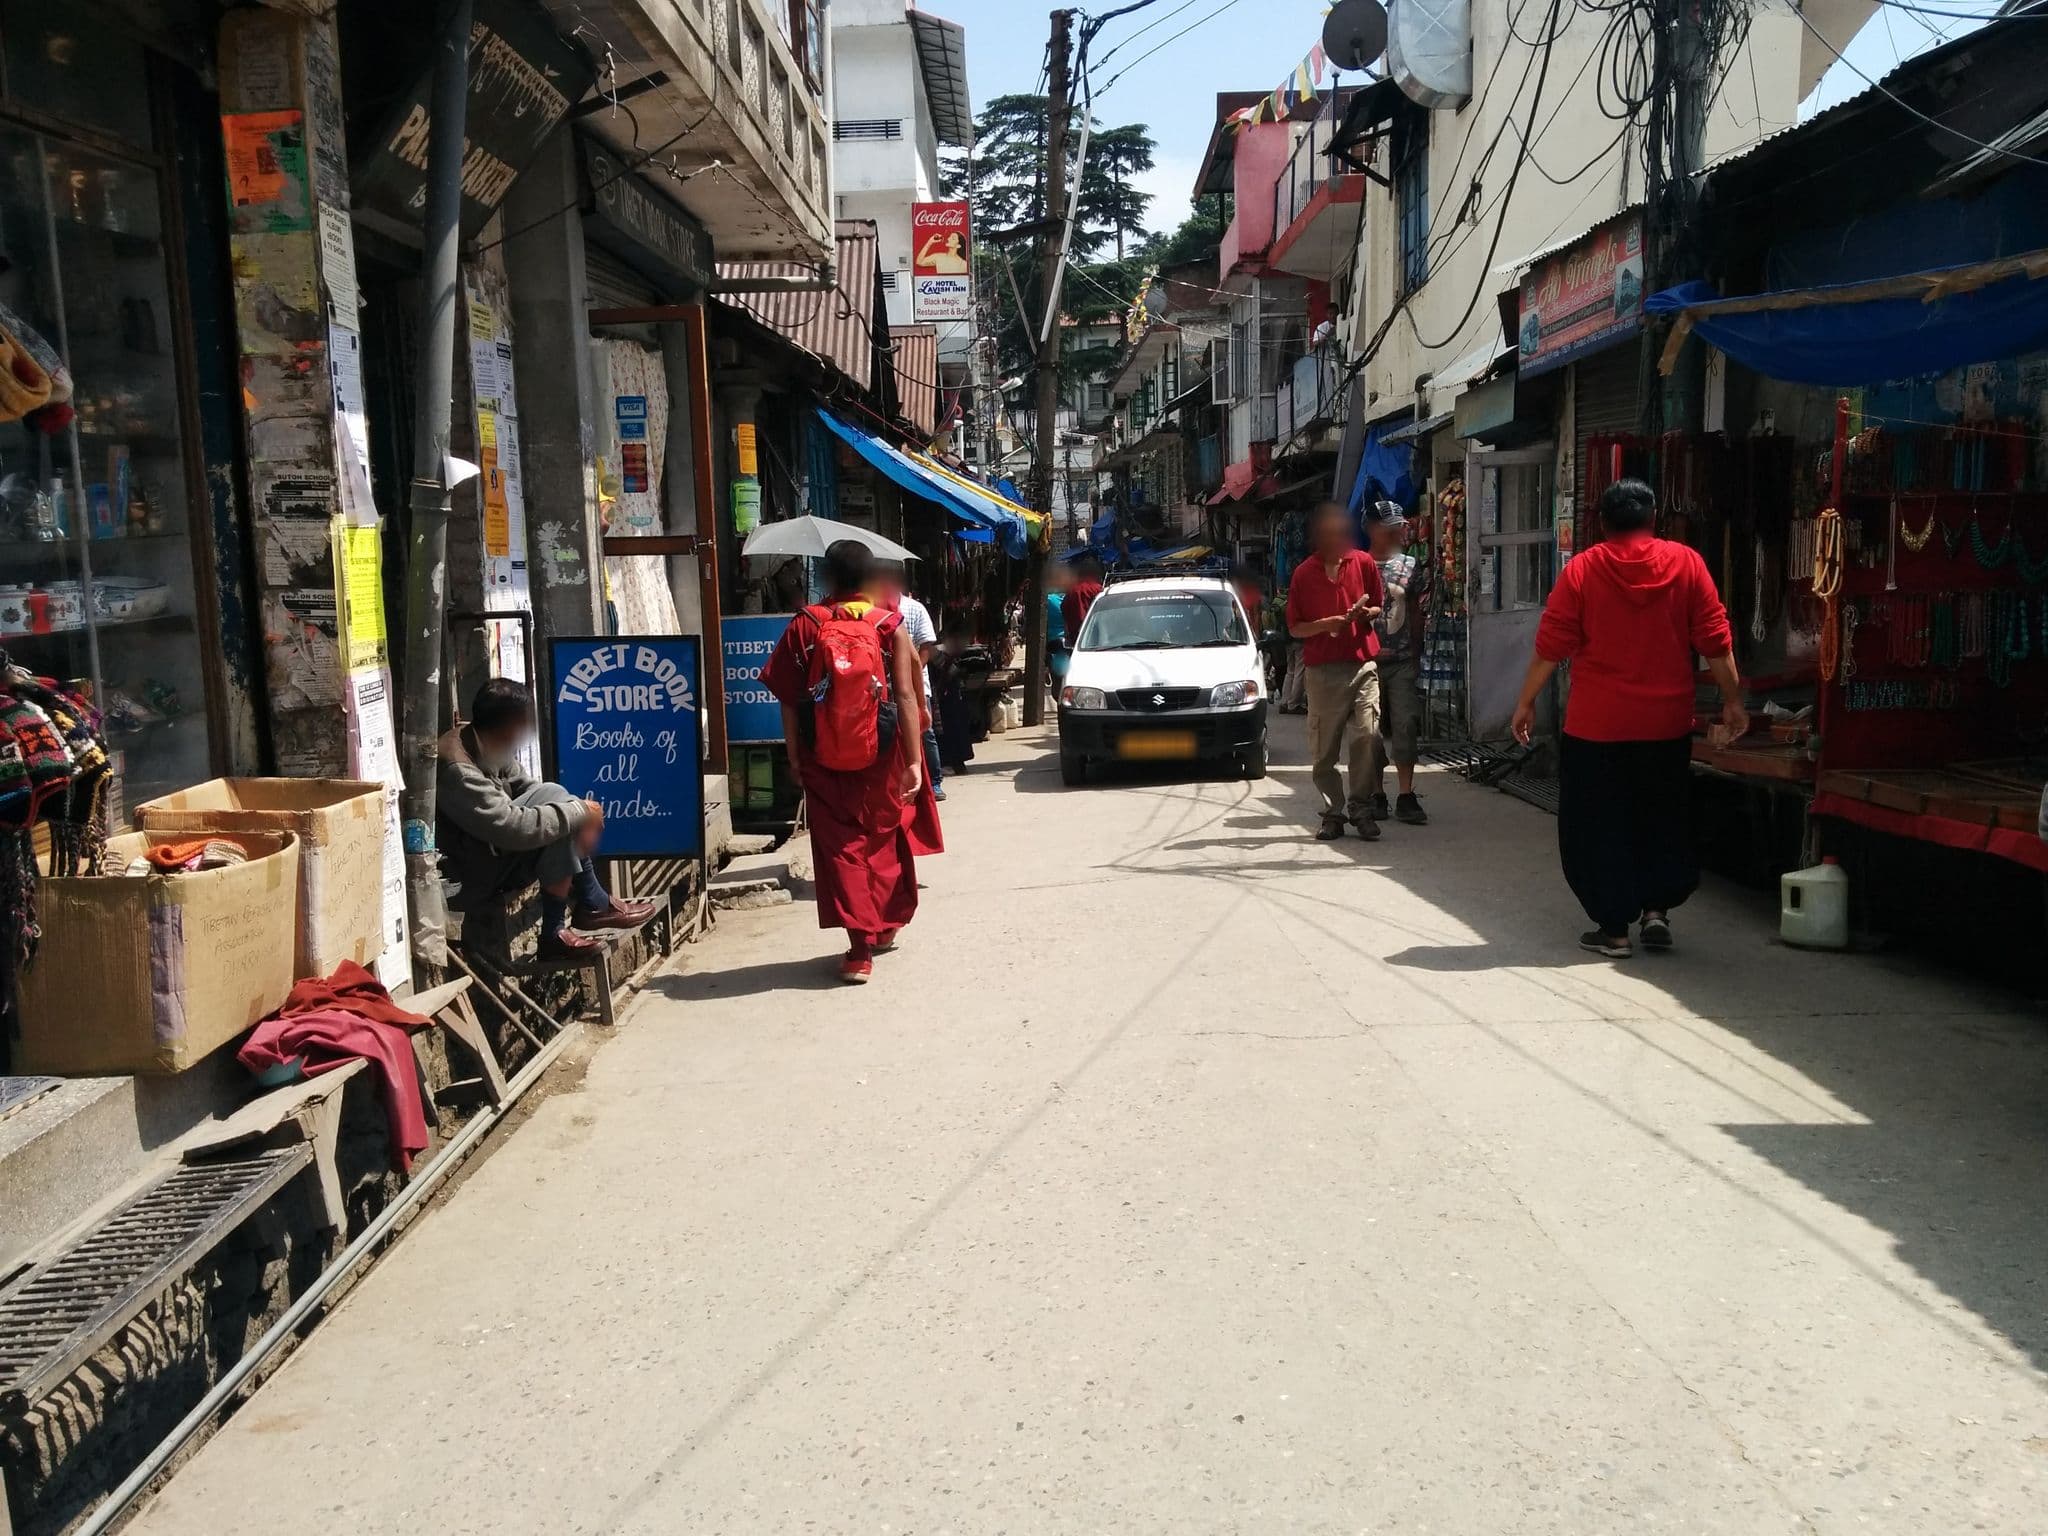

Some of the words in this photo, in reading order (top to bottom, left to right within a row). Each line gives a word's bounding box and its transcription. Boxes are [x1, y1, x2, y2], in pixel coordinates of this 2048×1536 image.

[1565, 234, 1618, 292] Travels
[917, 280, 951, 295] LAVISH
[923, 297, 941, 306] Black
[941, 297, 960, 307] Magic
[916, 307, 950, 316] Restaurant
[724, 640, 775, 655] TIBET
[559, 644, 630, 704] TIBET
[635, 646, 696, 713] BOOK
[726, 667, 764, 681] BOO
[585, 684, 665, 713] STORE
[723, 690, 779, 705] STORE
[572, 721, 645, 750] Books
[653, 730, 679, 764] of
[593, 753, 640, 782] all
